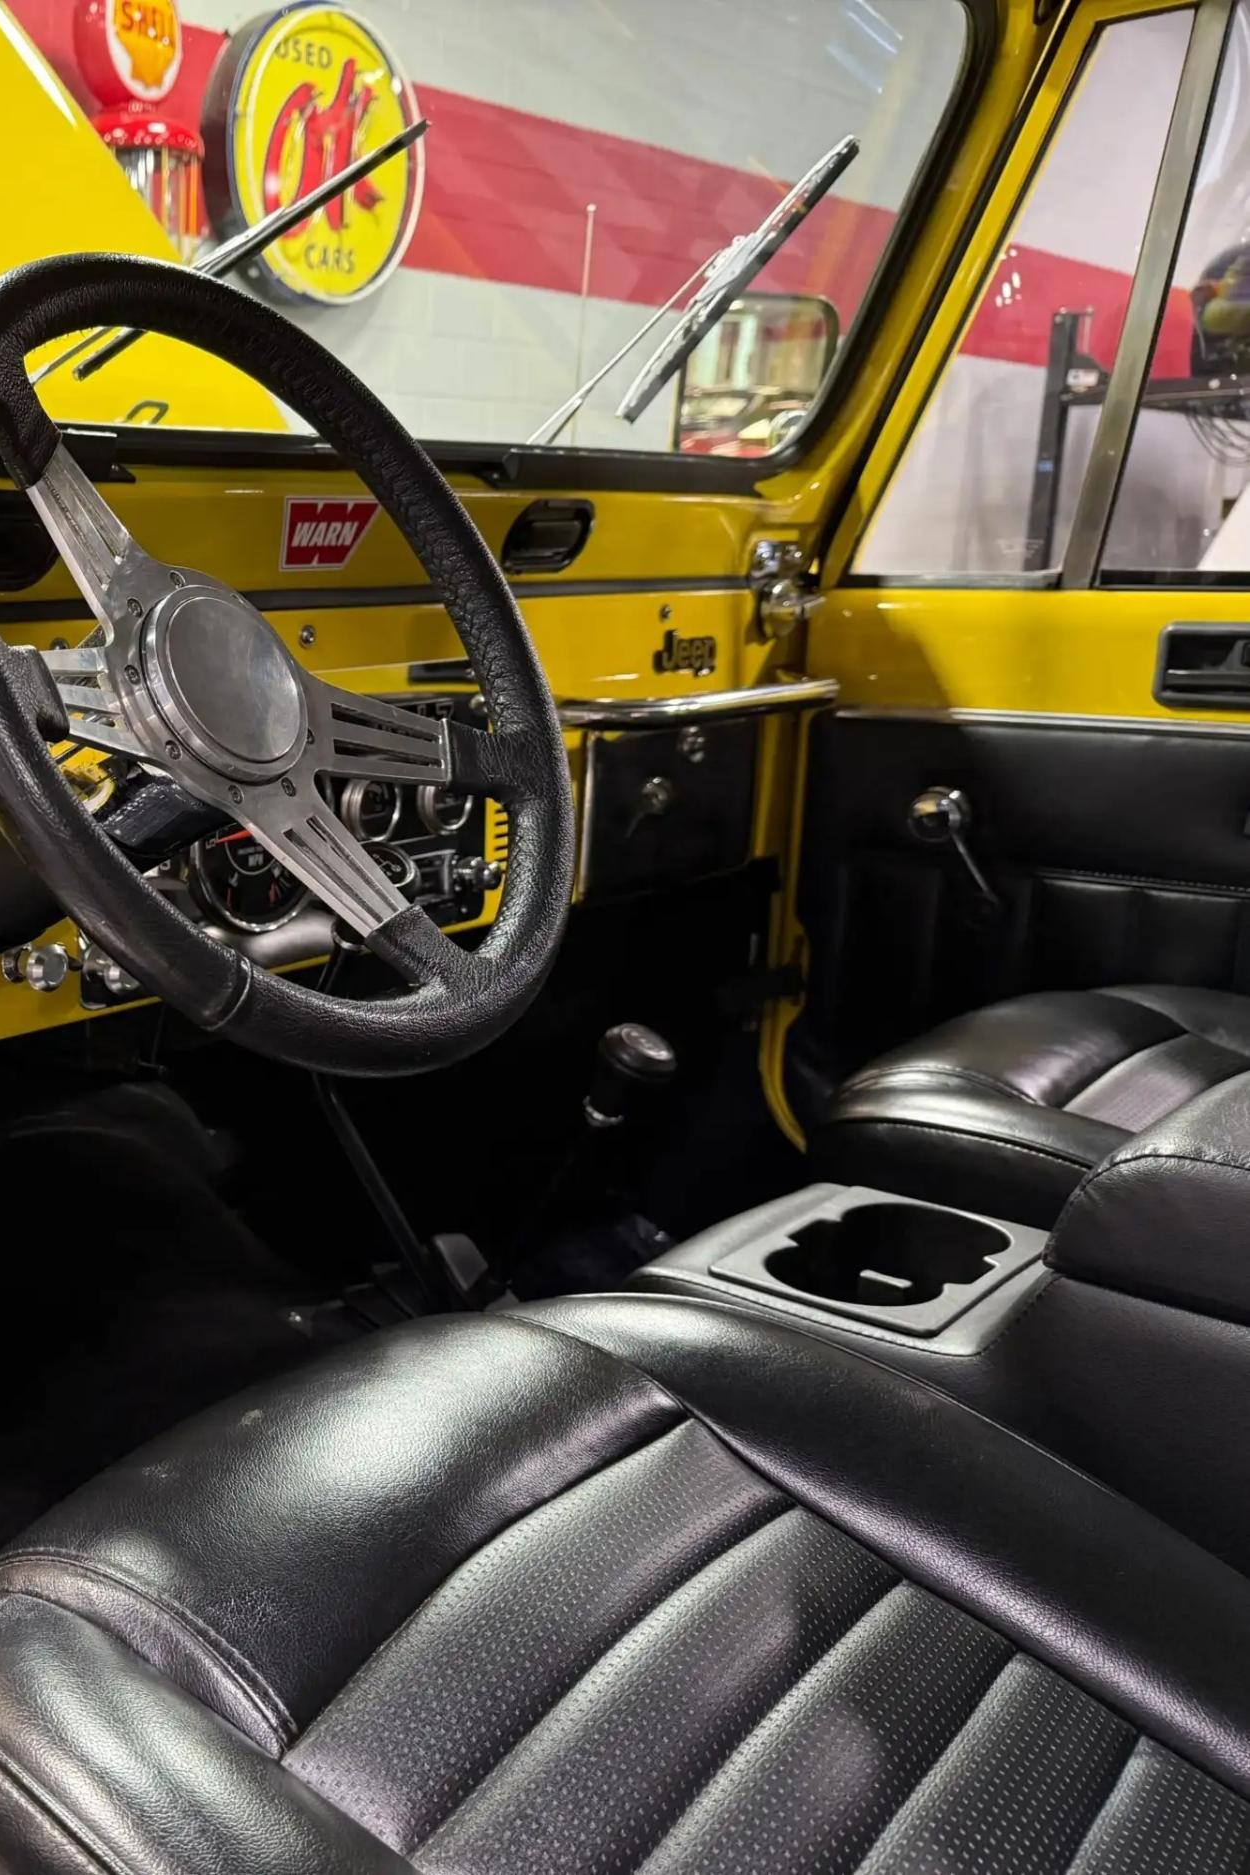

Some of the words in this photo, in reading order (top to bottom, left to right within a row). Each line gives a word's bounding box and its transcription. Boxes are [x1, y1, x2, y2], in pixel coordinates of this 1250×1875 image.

[275, 37, 333, 70] USED
[303, 243, 355, 275] CARS
[290, 521, 360, 548] WARN
[653, 629, 716, 677] Jeep
